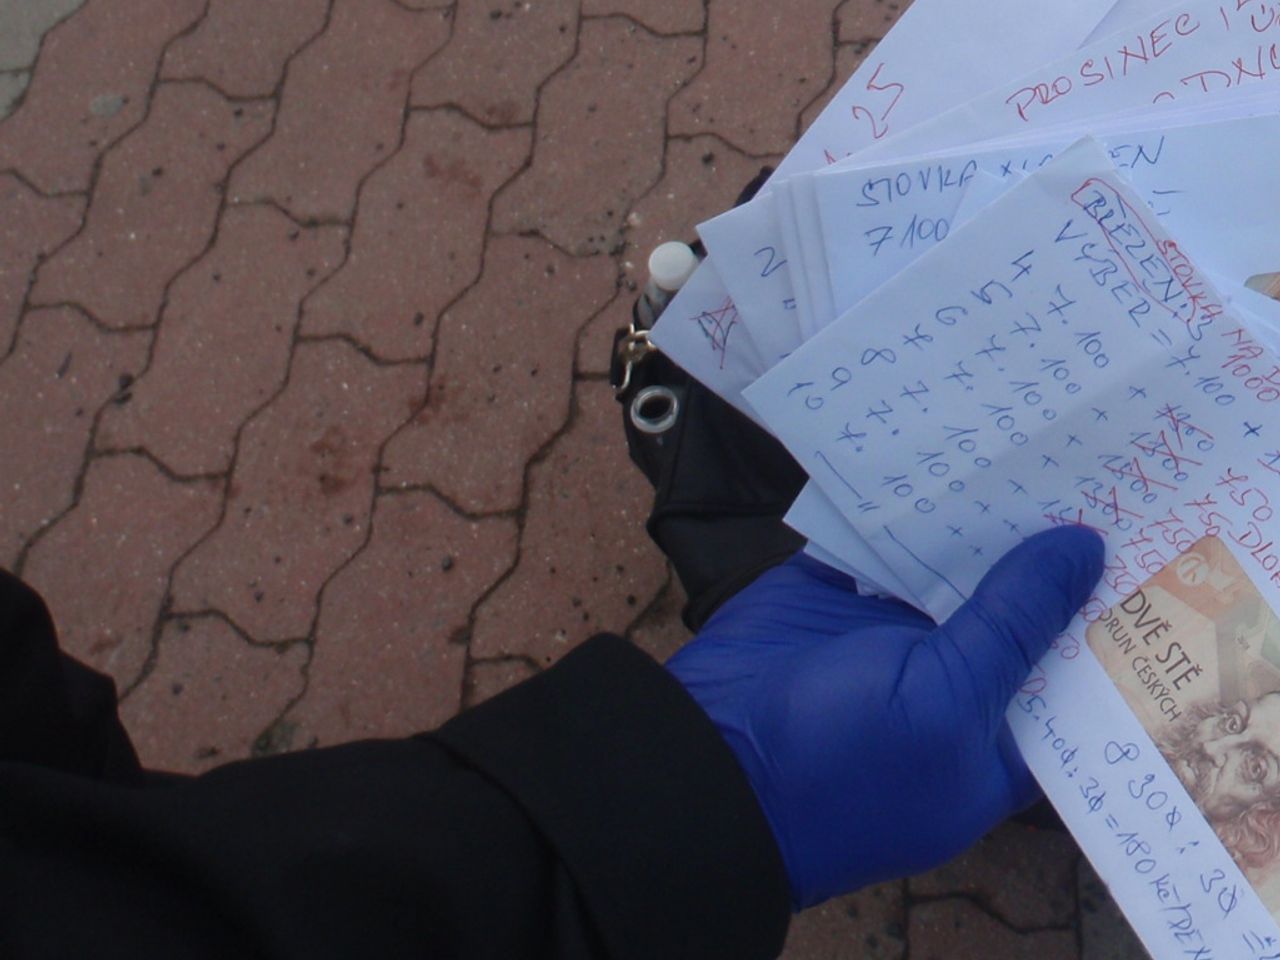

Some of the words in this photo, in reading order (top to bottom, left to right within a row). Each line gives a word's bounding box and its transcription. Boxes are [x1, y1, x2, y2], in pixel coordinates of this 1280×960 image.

[1005, 13, 1201, 121] PROSINEC
[861, 348, 896, 365] 8
[1221, 329, 1264, 359] NA
[1099, 609, 1137, 654] ORUN
[1132, 655, 1183, 722] ČESKÝCH
[1120, 590, 1172, 646] DVĚ
[1155, 641, 1203, 691] STĚ
